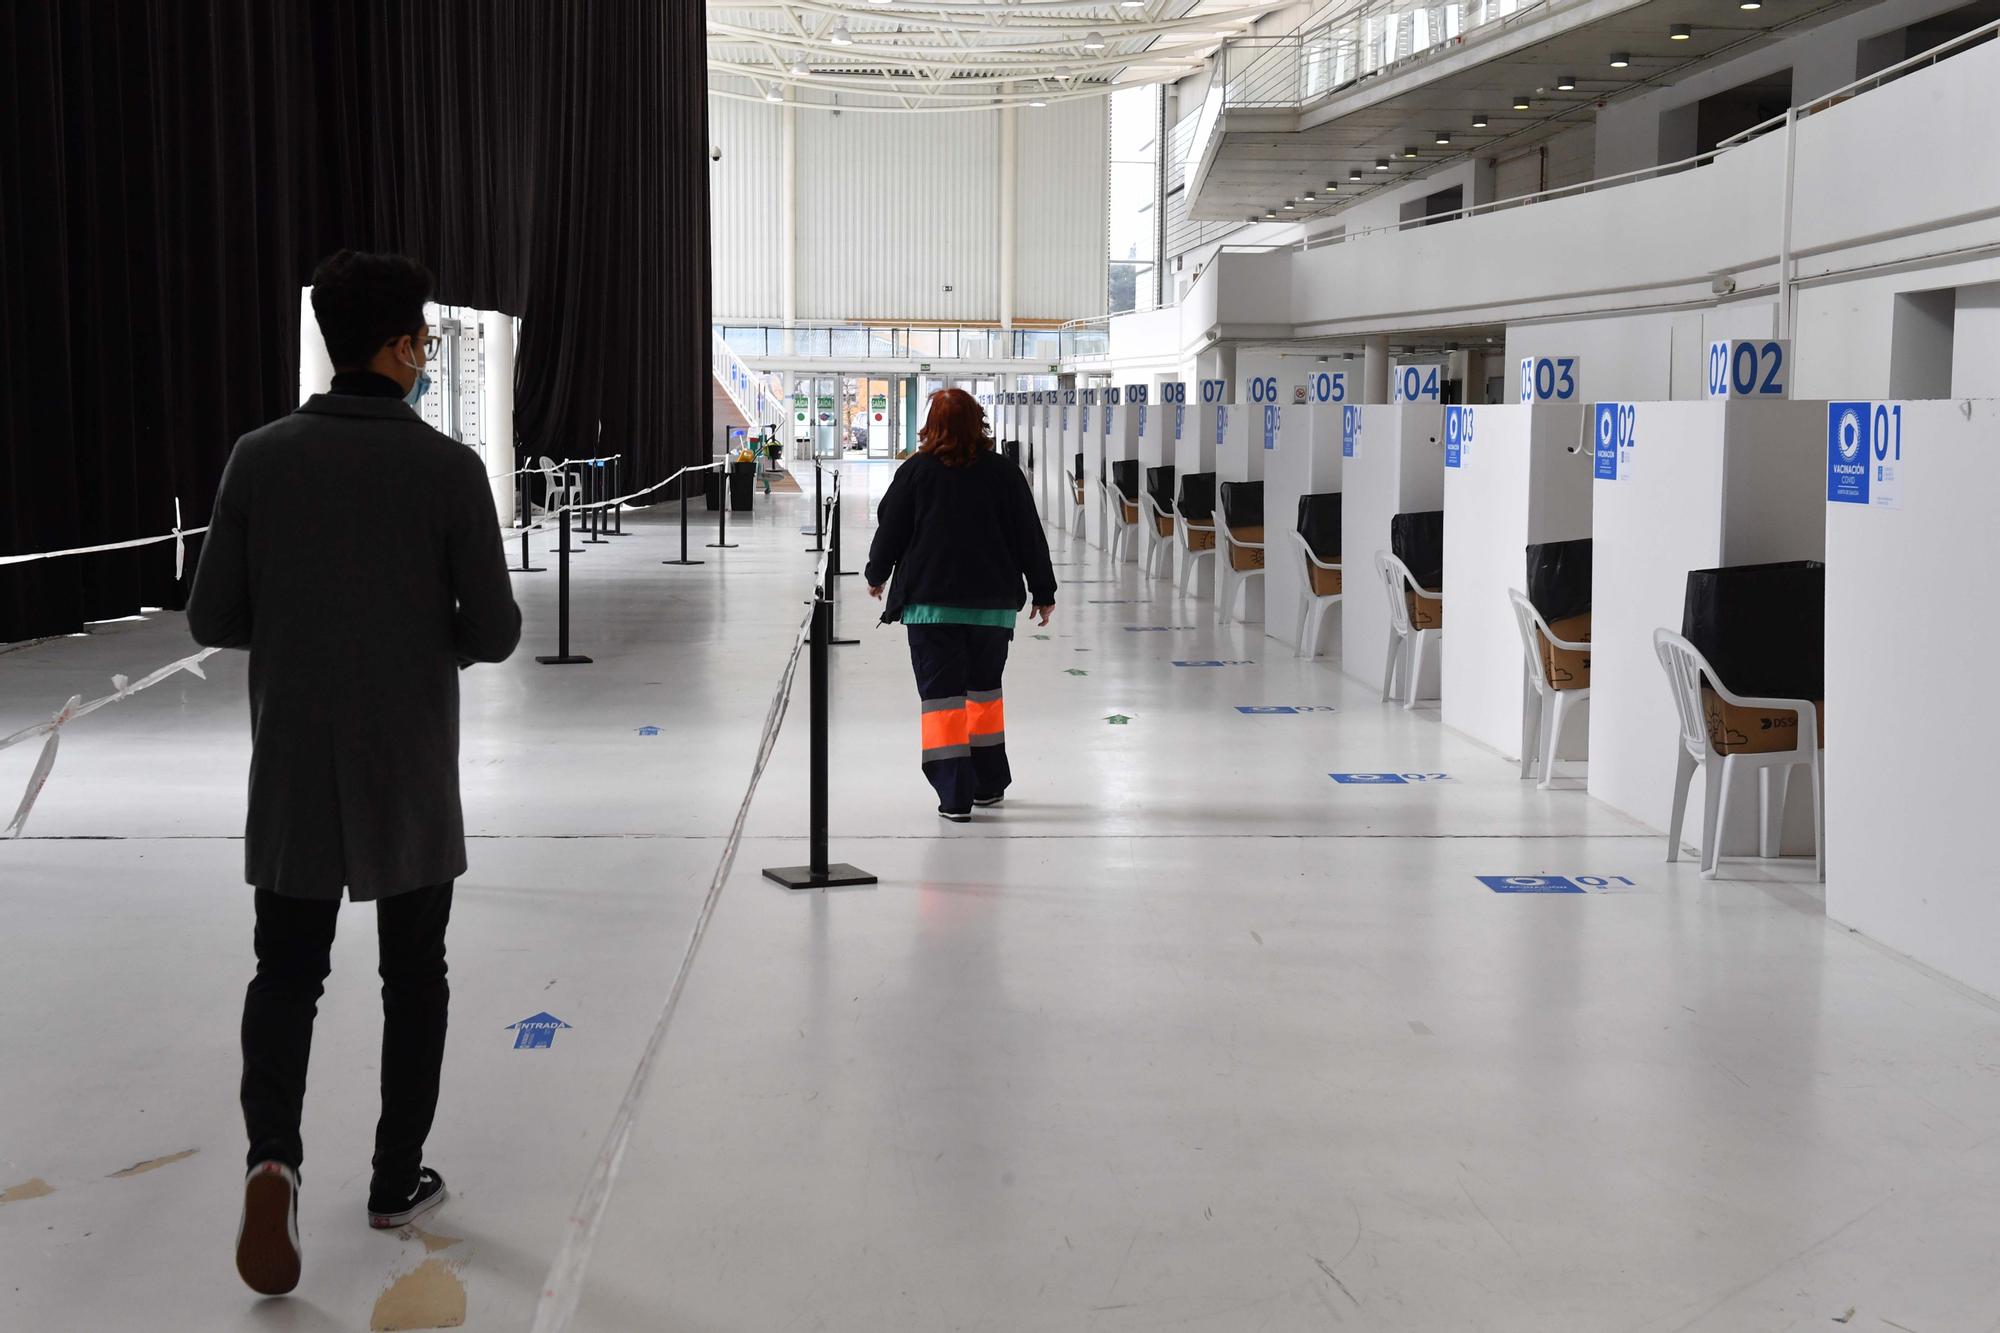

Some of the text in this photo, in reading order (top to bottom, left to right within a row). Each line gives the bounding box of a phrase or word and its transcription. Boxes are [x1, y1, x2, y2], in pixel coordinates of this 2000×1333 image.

[1709, 343, 1728, 395] 02
[1732, 342, 1783, 394] 02
[1316, 373, 1345, 402] 05
[1404, 367, 1440, 401] 04
[1521, 360, 1532, 401] 03
[1535, 358, 1575, 399] 03
[996, 393, 1004, 405] 17
[1006, 392, 1015, 405] 16
[1017, 392, 1028, 405] 15
[1031, 391, 1043, 405] 14
[1046, 391, 1058, 404] 13
[1063, 390, 1075, 405] 12
[1082, 389, 1094, 405] 11
[1104, 387, 1120, 405] 10
[1129, 384, 1147, 403] 09
[1164, 382, 1185, 403] 08
[1203, 380, 1225, 403] 07
[1252, 377, 1278, 402] 06
[1462, 407, 1474, 442] 03
[1618, 404, 1635, 448] 02
[1873, 404, 1902, 461] 01
[1834, 463, 1865, 475] VACINACIÓN
[1401, 772, 1454, 780] 02
[1574, 876, 1637, 886] 01
